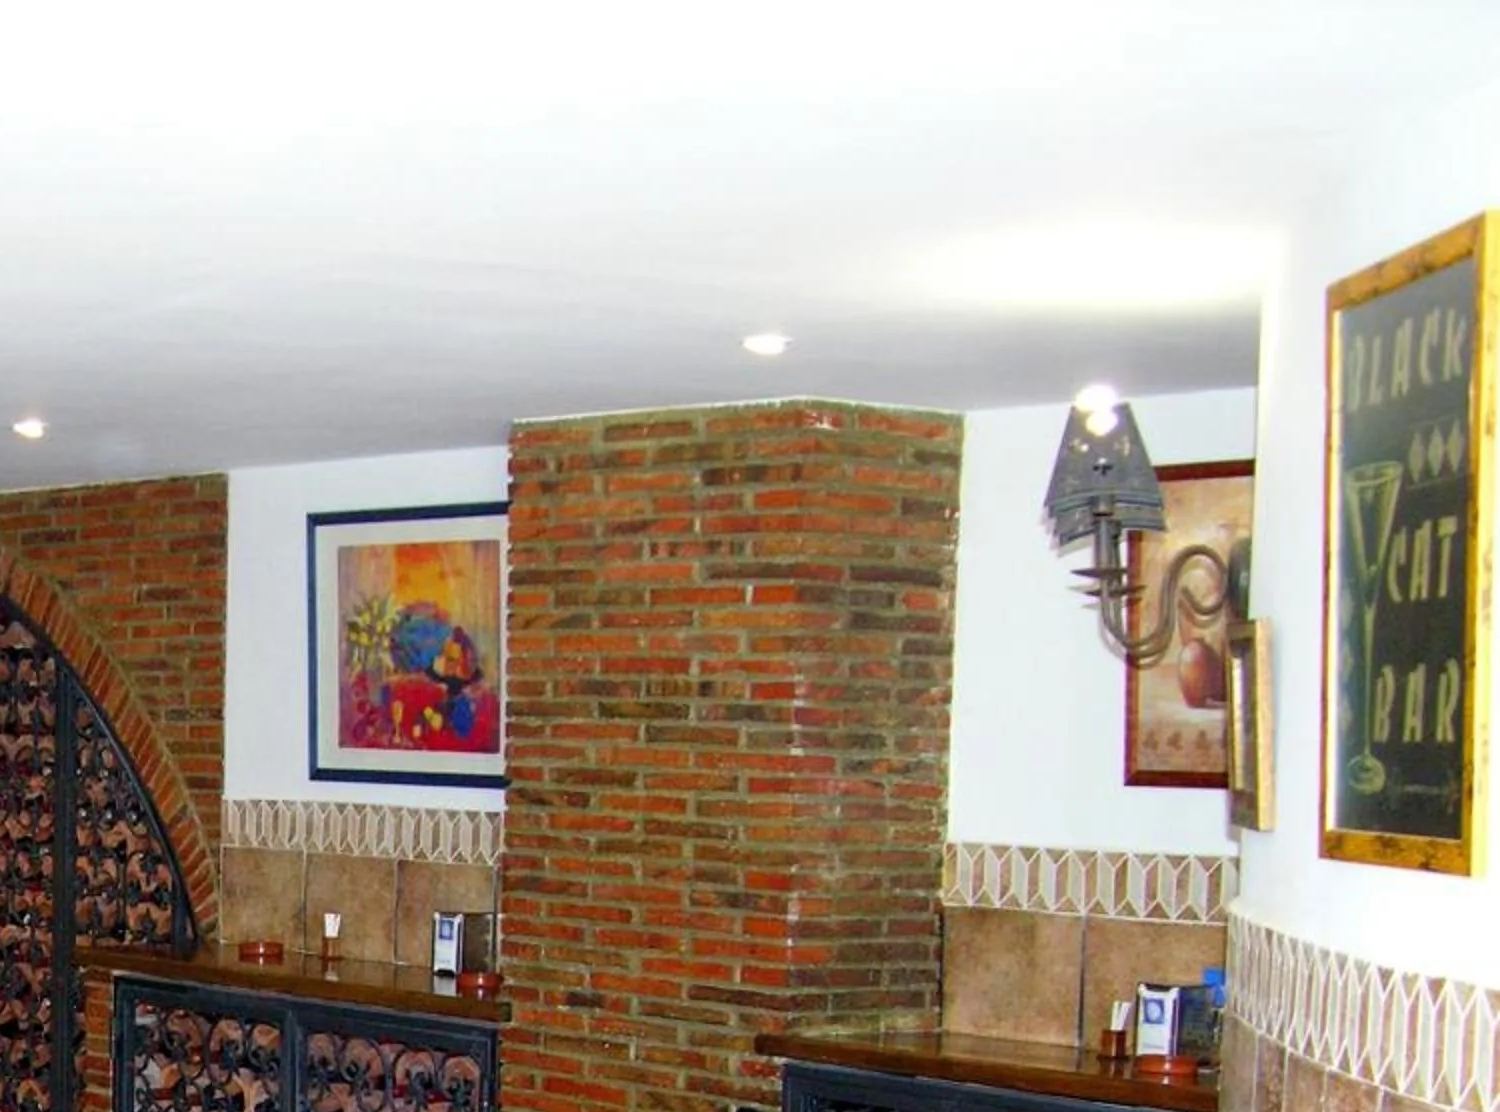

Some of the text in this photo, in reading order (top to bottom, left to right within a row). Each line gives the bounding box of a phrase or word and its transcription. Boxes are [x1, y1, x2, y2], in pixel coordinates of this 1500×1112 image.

[1347, 307, 1468, 411] BLACK
[1388, 516, 1458, 602] CAT
[1373, 657, 1460, 742] BAR
